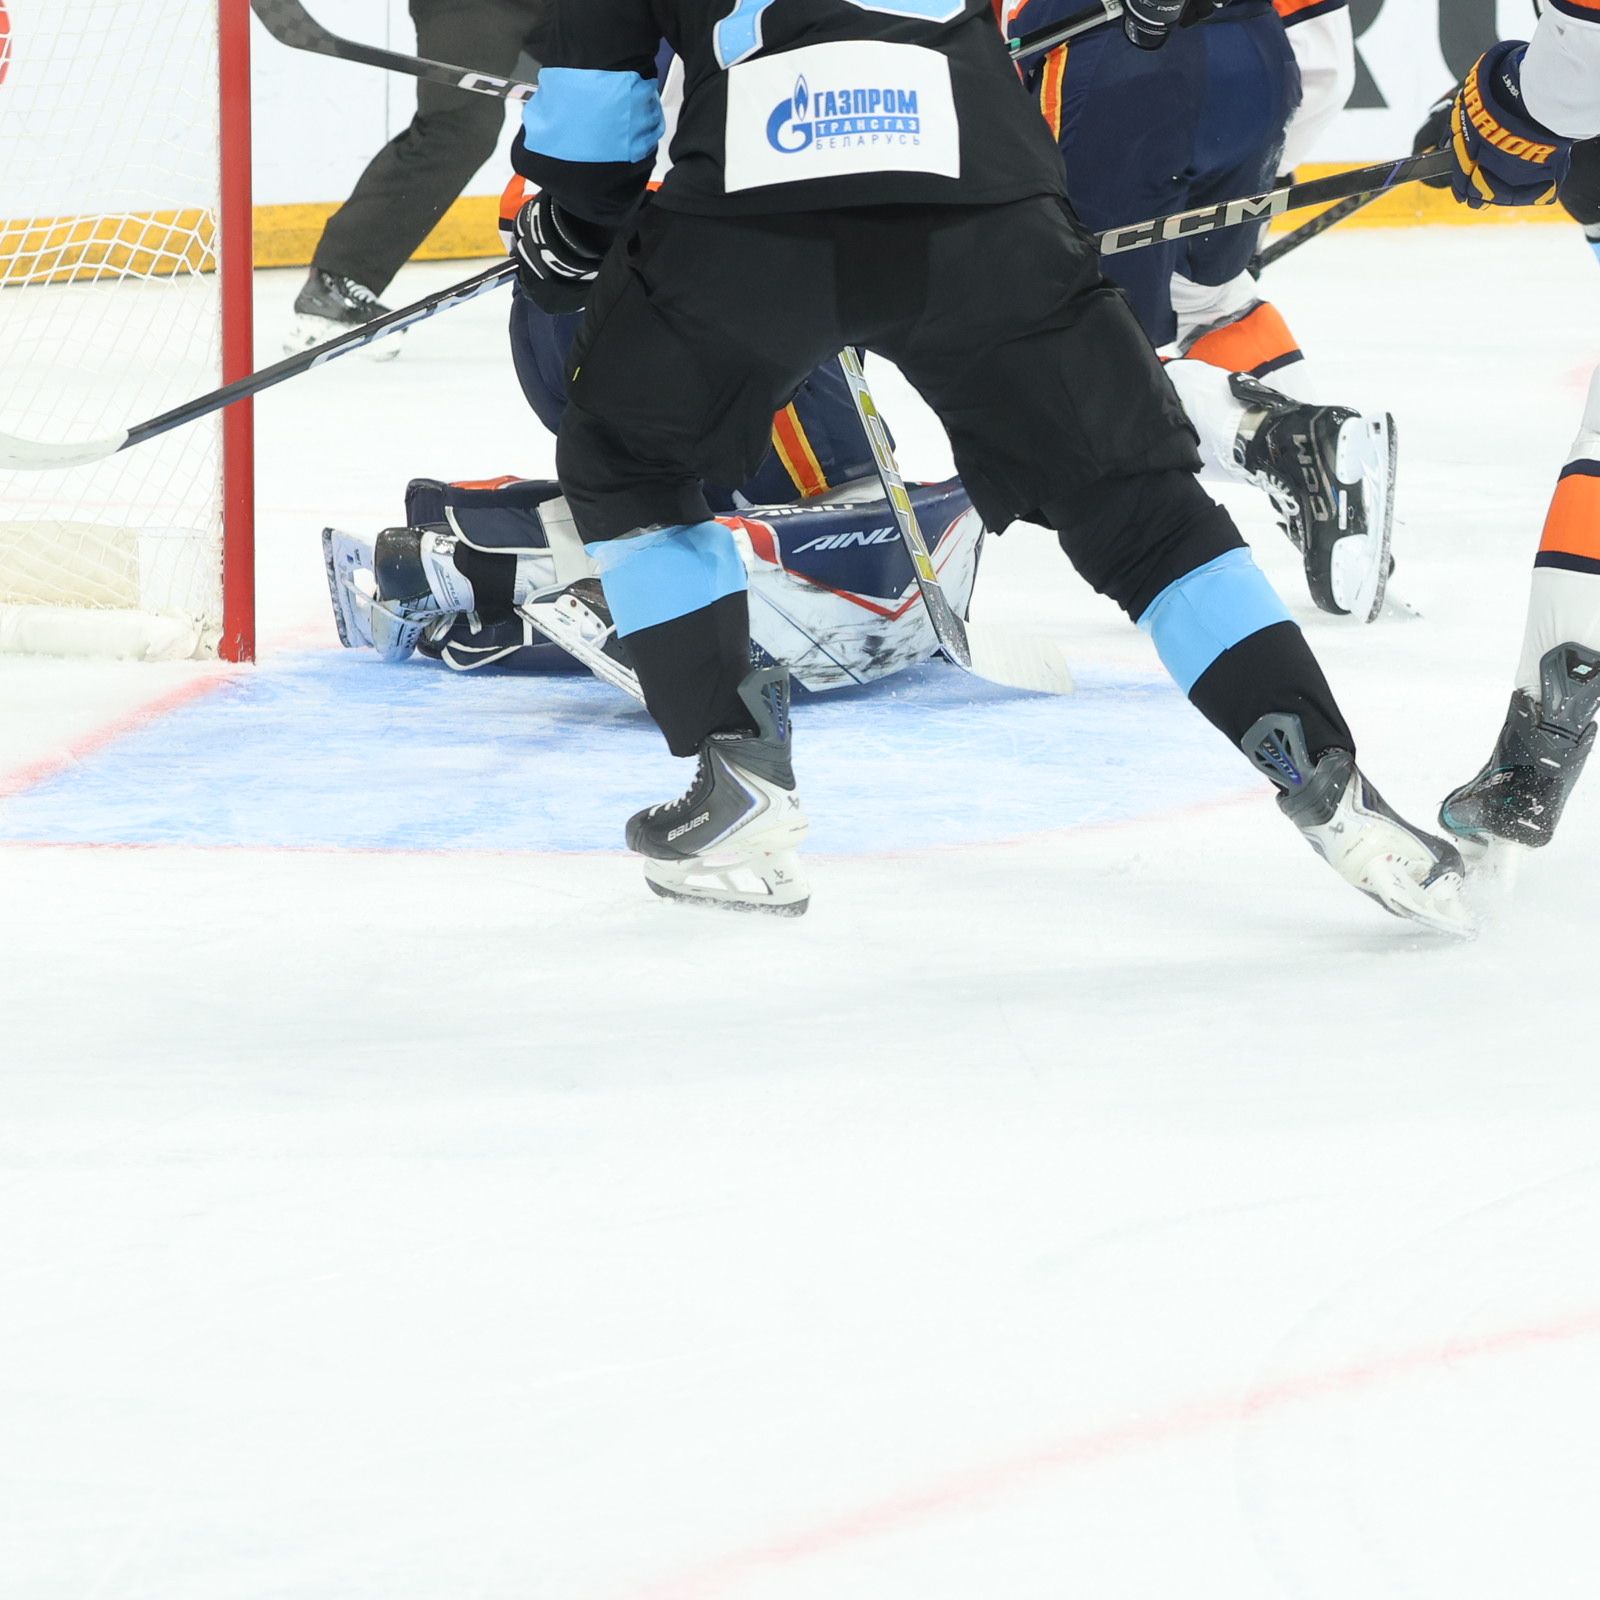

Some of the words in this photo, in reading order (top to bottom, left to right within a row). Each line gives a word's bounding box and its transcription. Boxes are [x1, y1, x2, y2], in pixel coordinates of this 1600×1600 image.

[813, 89, 918, 118] ГАЗПРОМ
[817, 117, 919, 134] ТРАНСГАЗ
[815, 134, 921, 151] БЕЛАРУСЬ
[1100, 187, 1291, 256] CCM
[1292, 434, 1330, 522] CCM
[667, 811, 710, 842] BAUER
